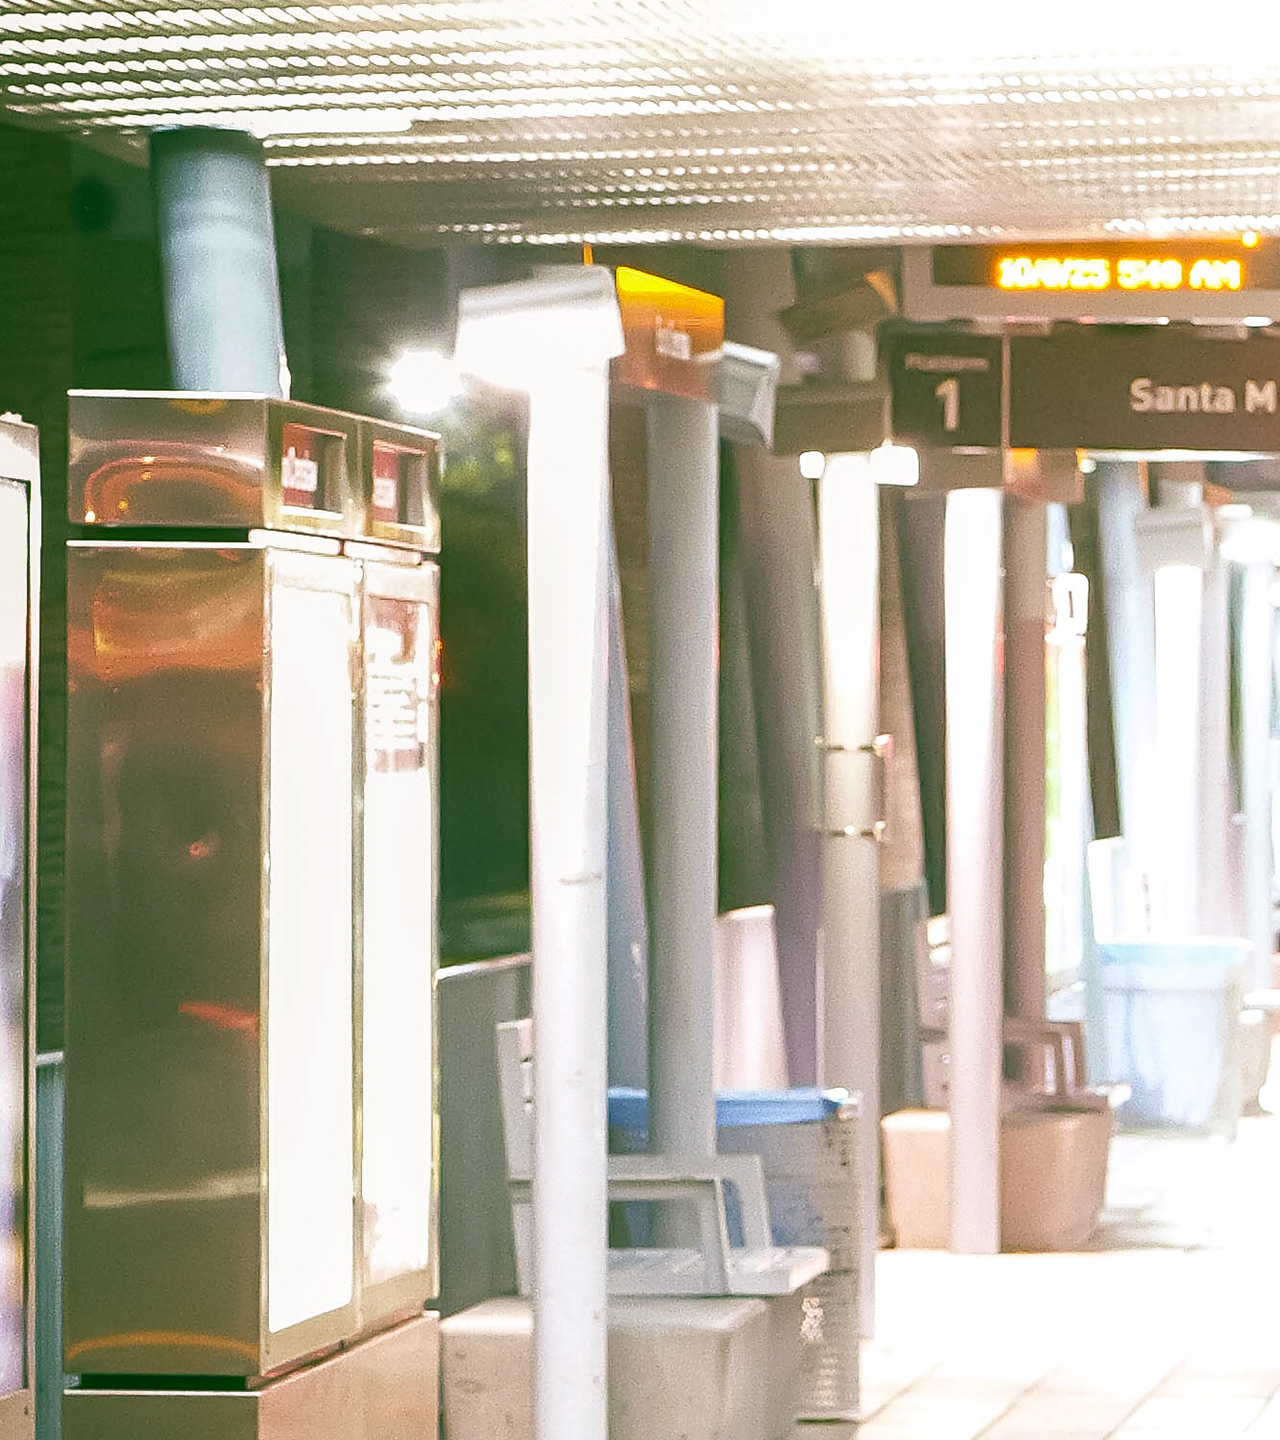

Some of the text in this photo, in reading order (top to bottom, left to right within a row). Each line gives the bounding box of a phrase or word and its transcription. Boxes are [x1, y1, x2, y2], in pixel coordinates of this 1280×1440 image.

[1189, 259, 1241, 290] AM
[935, 378, 961, 431] 1
[1129, 377, 1234, 414] Santa
